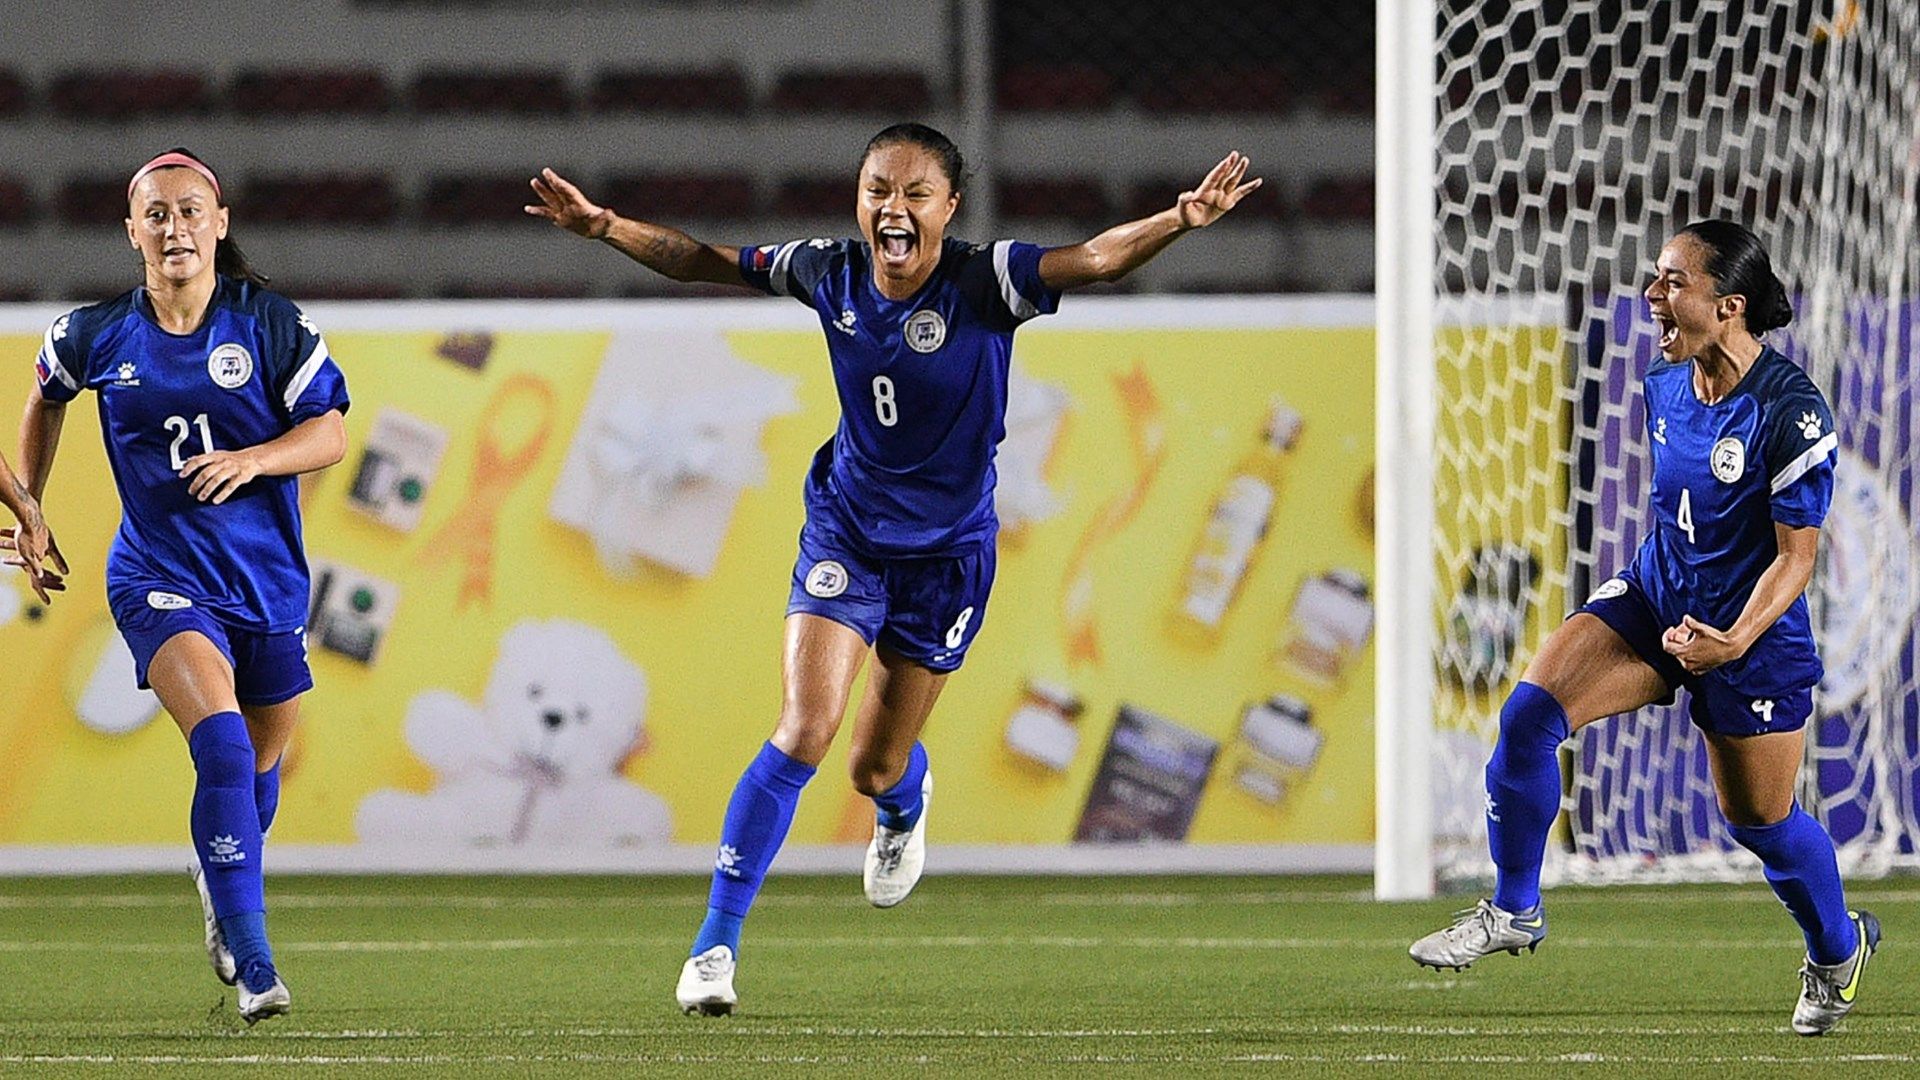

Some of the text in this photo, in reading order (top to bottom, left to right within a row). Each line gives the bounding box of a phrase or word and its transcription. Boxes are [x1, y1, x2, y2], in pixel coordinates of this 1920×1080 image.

[872, 375, 898, 427] 8
[163, 412, 215, 471] 21
[1677, 488, 1696, 544] 4
[946, 606, 974, 649] 8
[1751, 700, 1775, 722] 4
